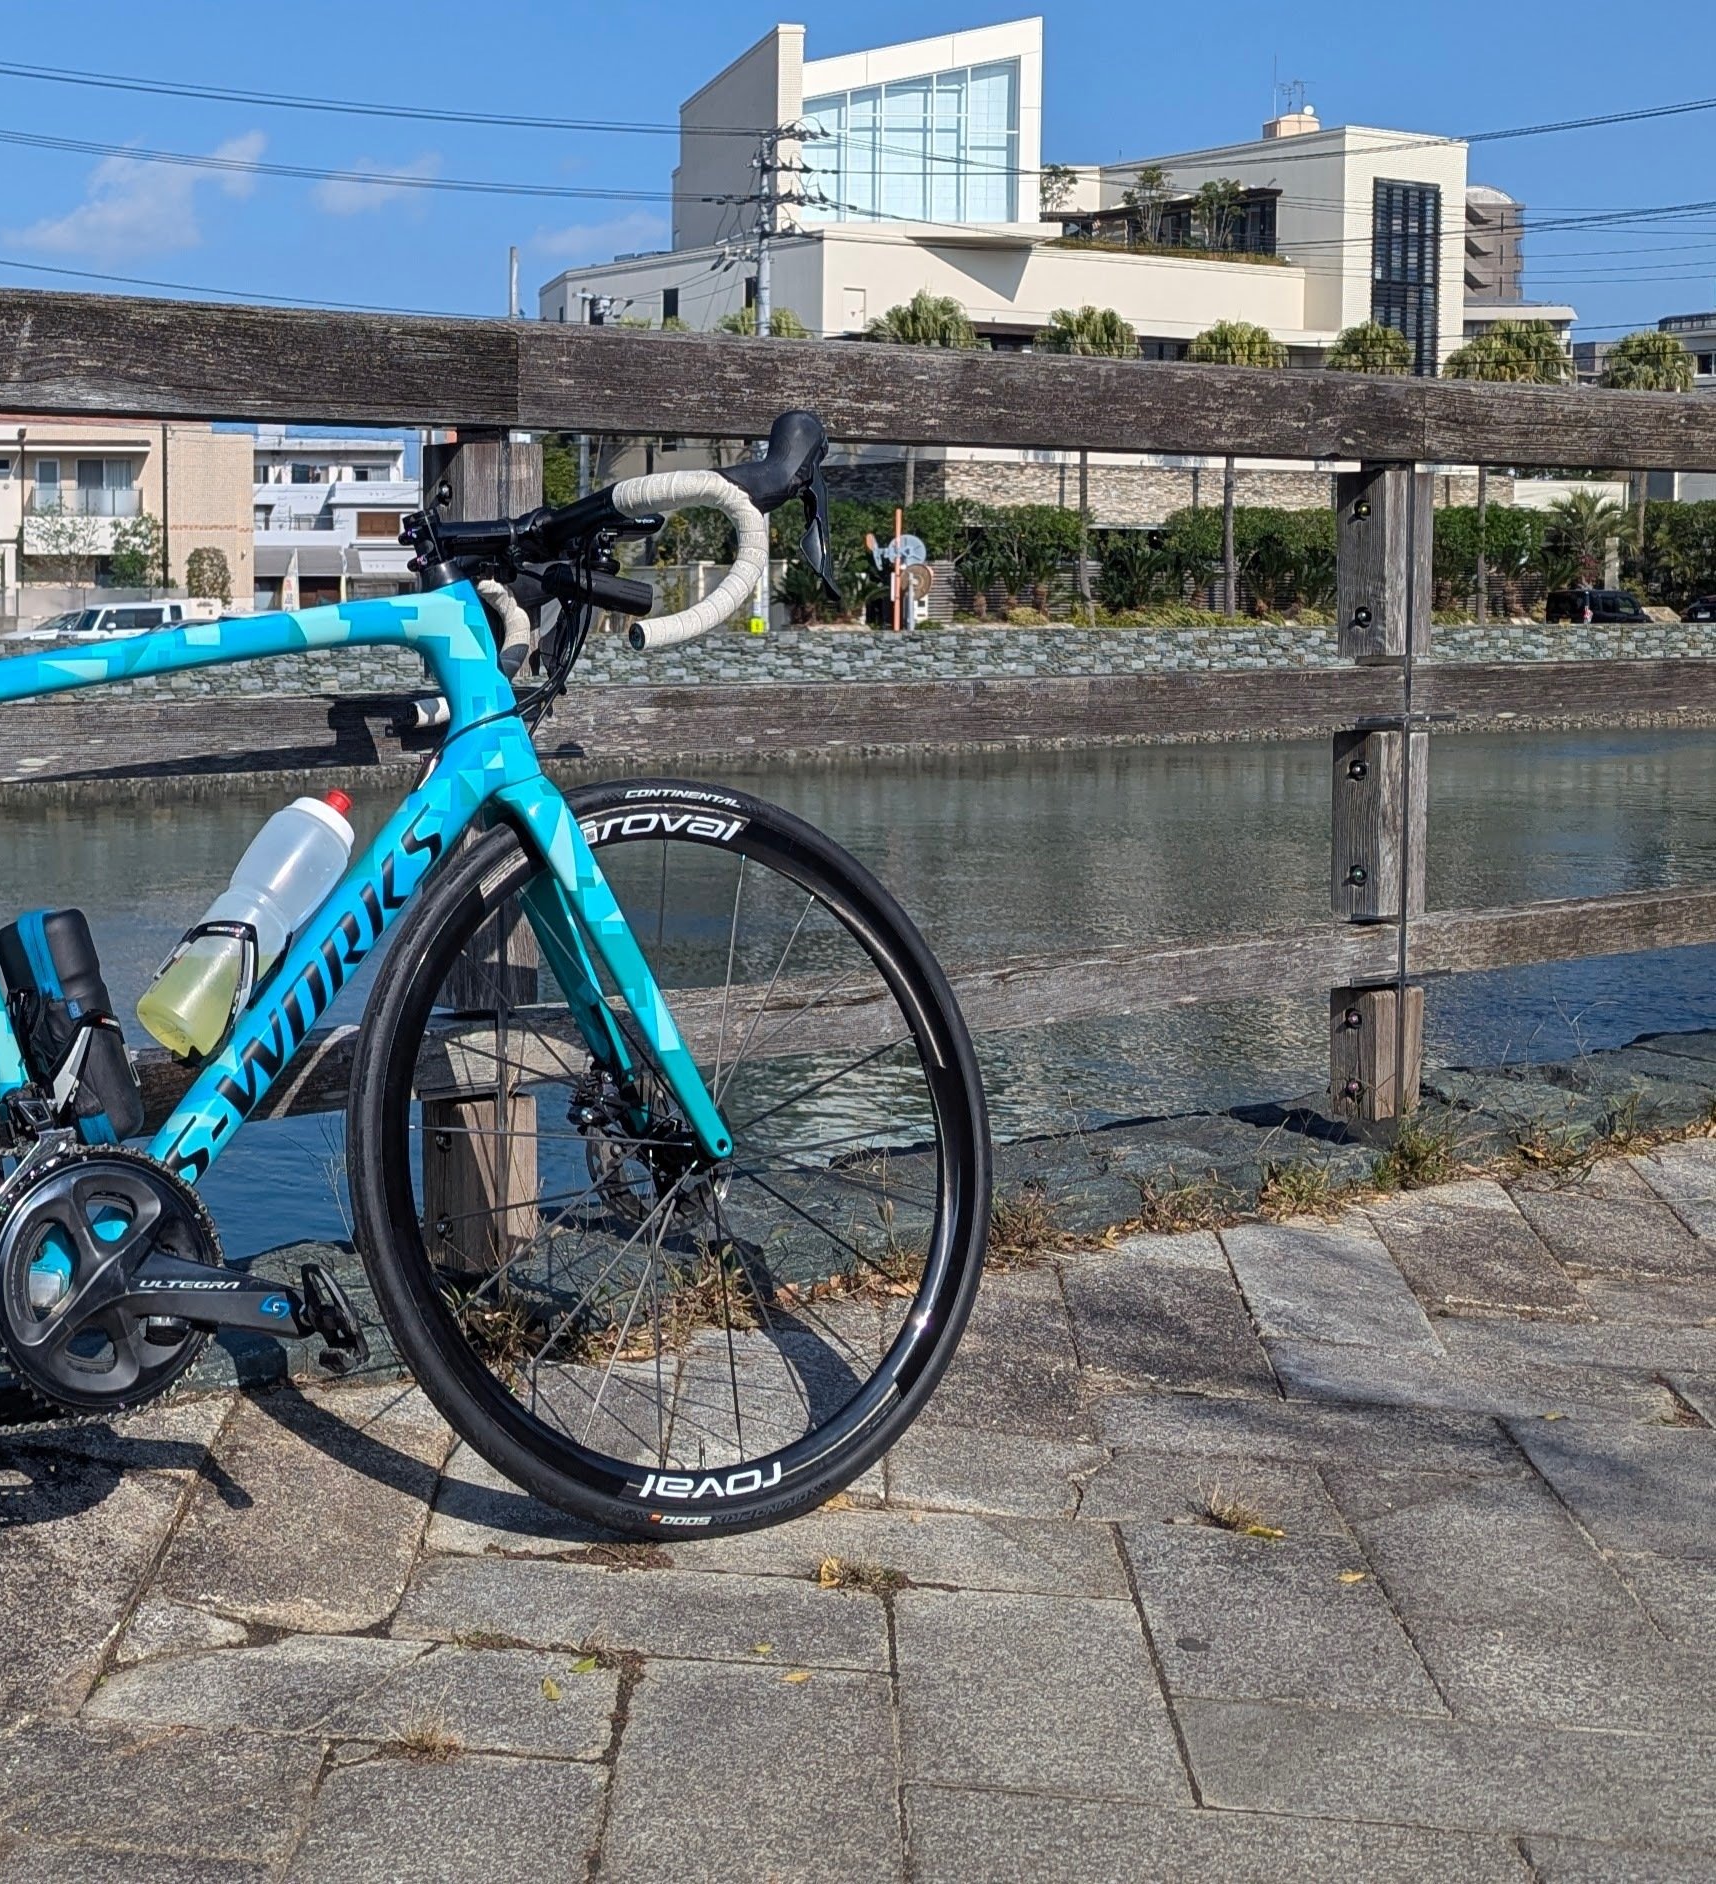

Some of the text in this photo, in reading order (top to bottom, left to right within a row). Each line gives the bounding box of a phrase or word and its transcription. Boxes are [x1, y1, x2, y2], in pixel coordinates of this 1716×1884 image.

[624, 788, 741, 808] CONTINENTAL
[600, 813, 742, 841] roval
[139, 1279, 240, 1290] ULTEGRA
[639, 1462, 782, 1499] roval
[659, 1515, 712, 1526] 5000
